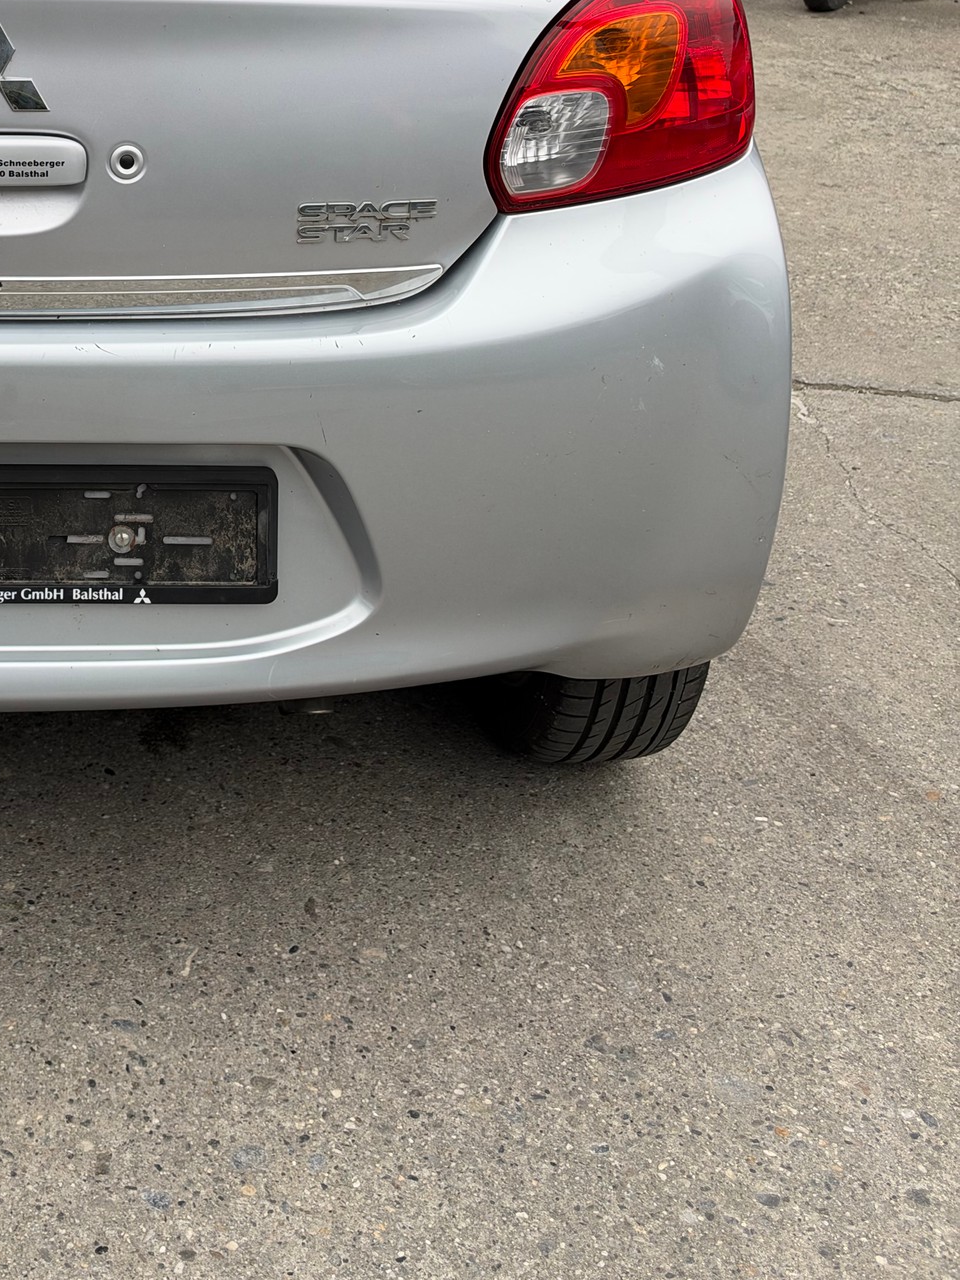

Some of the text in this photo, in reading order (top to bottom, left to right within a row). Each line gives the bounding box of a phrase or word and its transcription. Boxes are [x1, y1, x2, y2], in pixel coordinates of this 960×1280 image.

[8, 170, 49, 178] Balsthal
[297, 198, 438, 222] SPACE
[296, 222, 411, 245] STAR
[20, 588, 64, 601] GmbH
[72, 588, 124, 601] Balsthal
